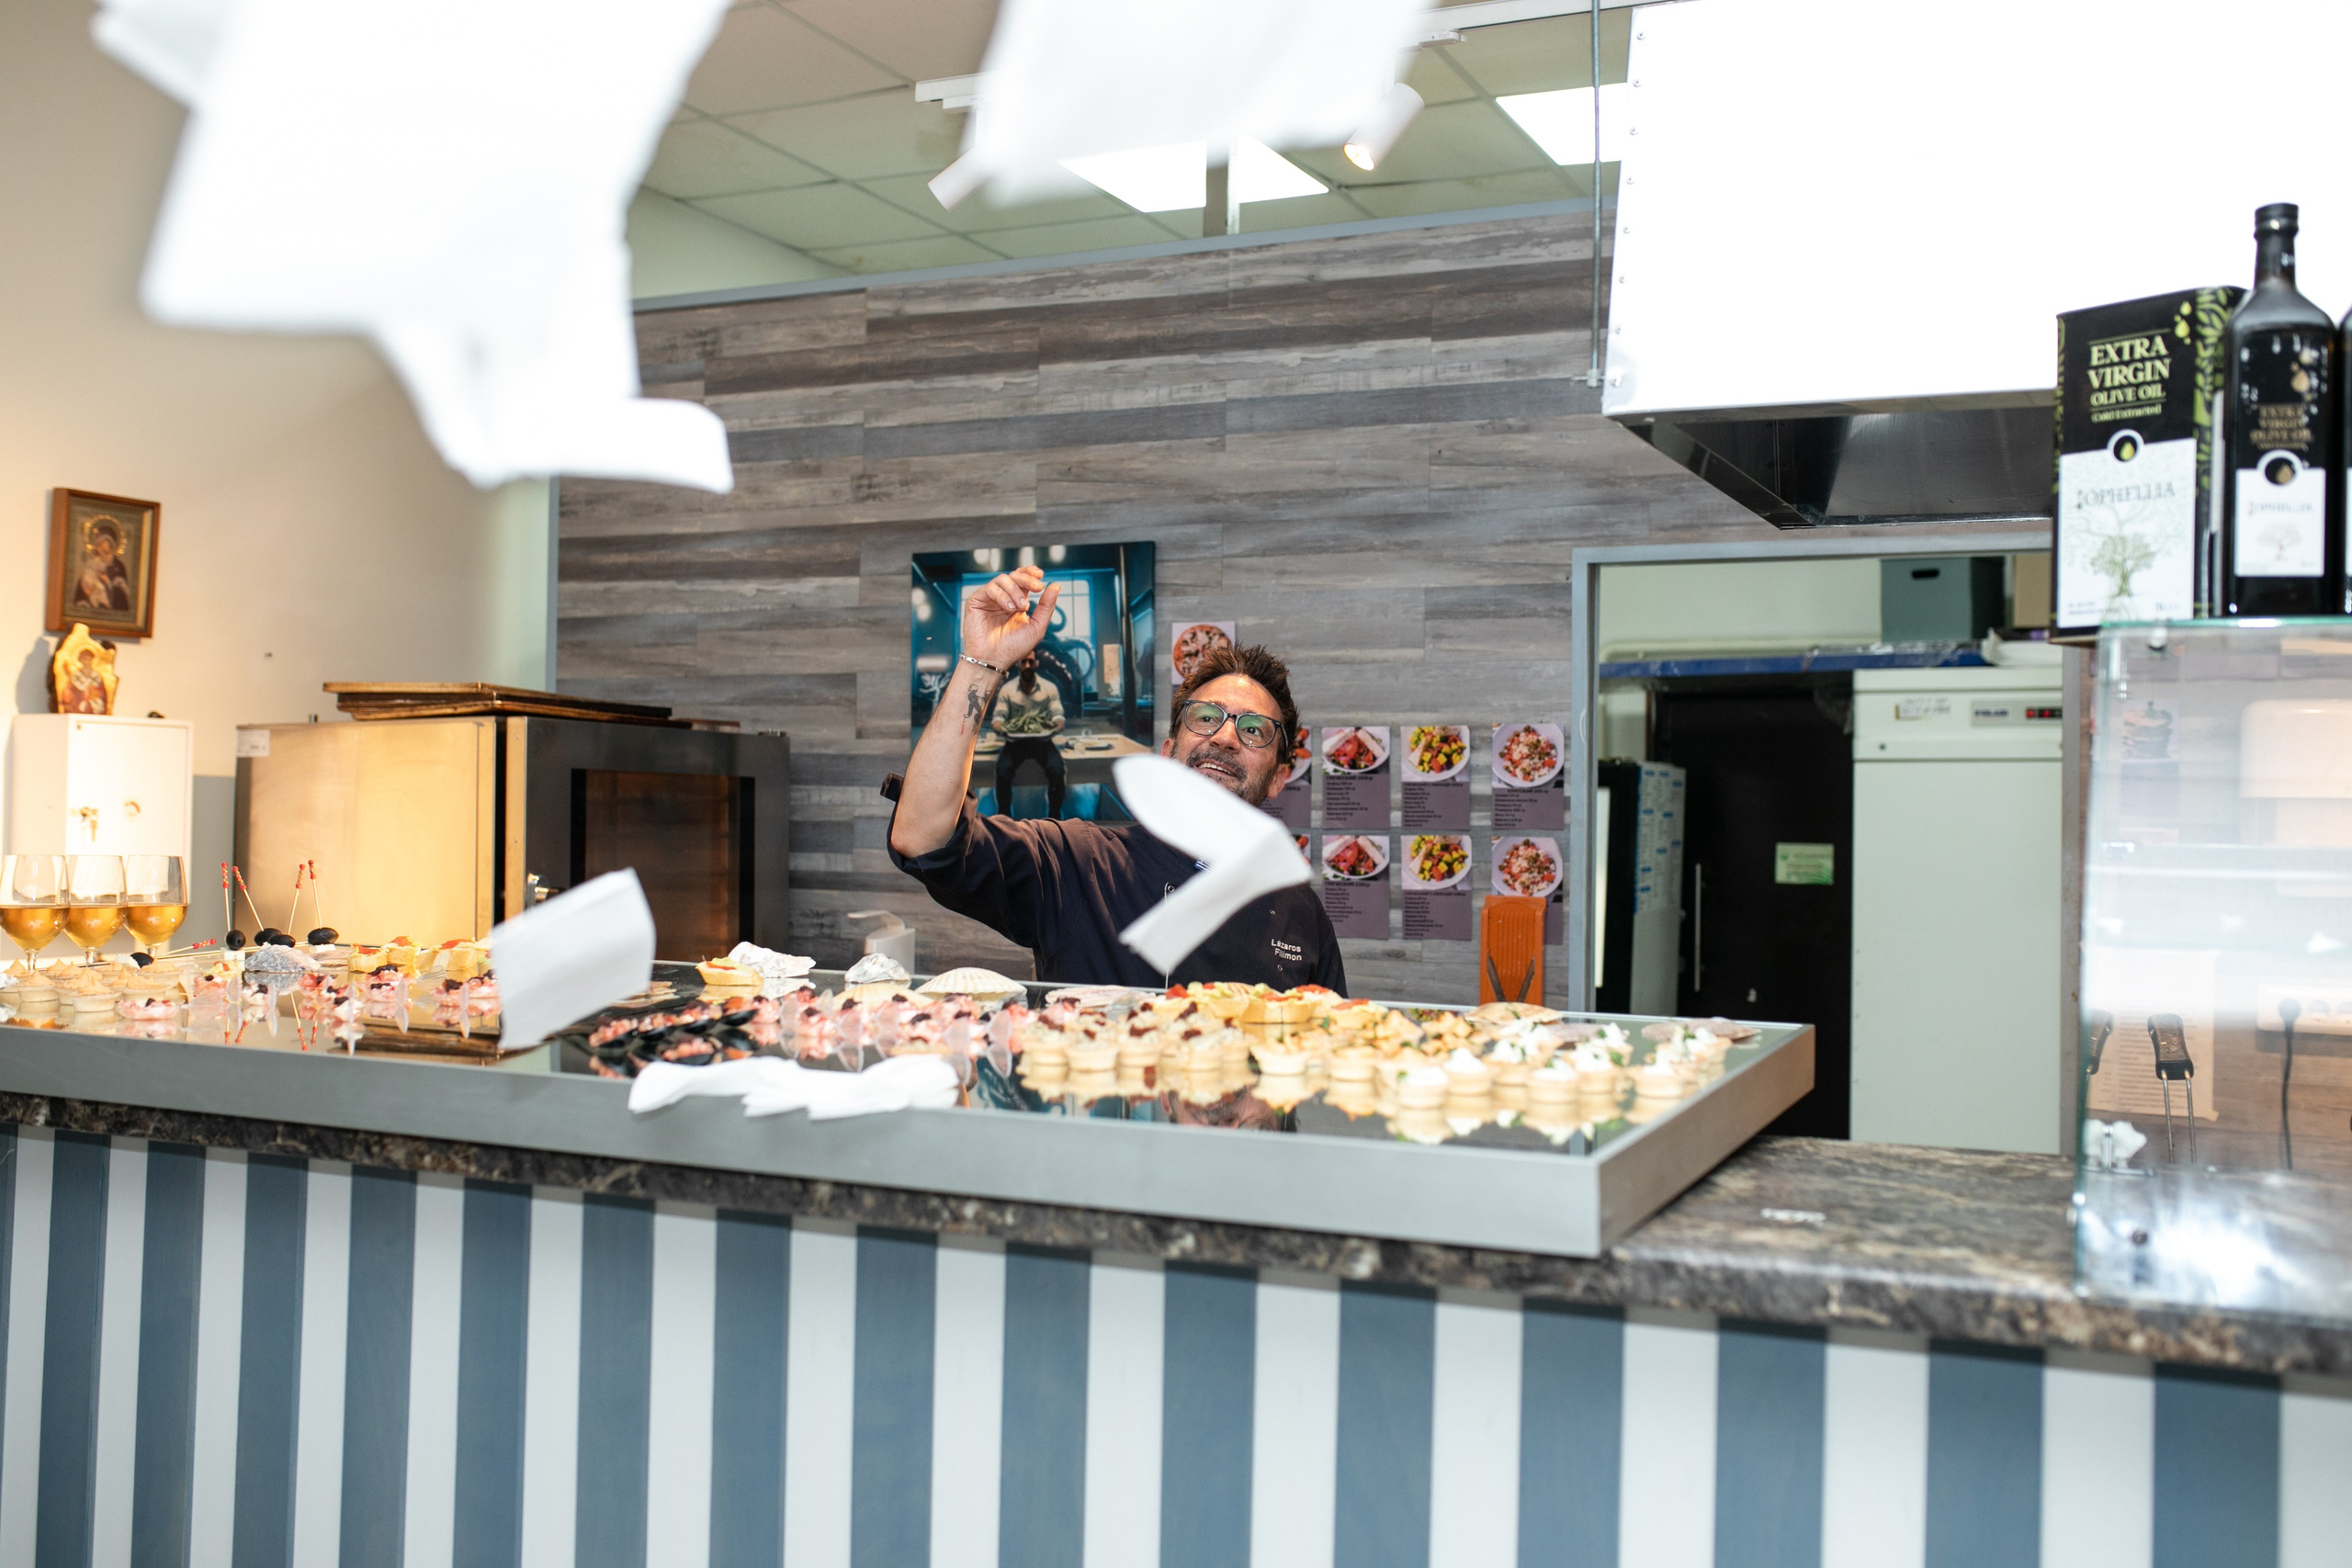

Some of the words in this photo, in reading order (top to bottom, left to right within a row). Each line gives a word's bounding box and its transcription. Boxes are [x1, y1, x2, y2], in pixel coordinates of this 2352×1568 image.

[2090, 334, 2169, 367] EXTRA
[2087, 357, 2172, 389] VIRGIN
[2090, 387, 2137, 407] OLIVE
[2137, 383, 2166, 400] OIL
[2091, 410, 2115, 423] Cold
[2117, 403, 2162, 421] Extracted
[1271, 938, 1302, 953] Lazaros
[1274, 948, 1303, 962] Filimon
